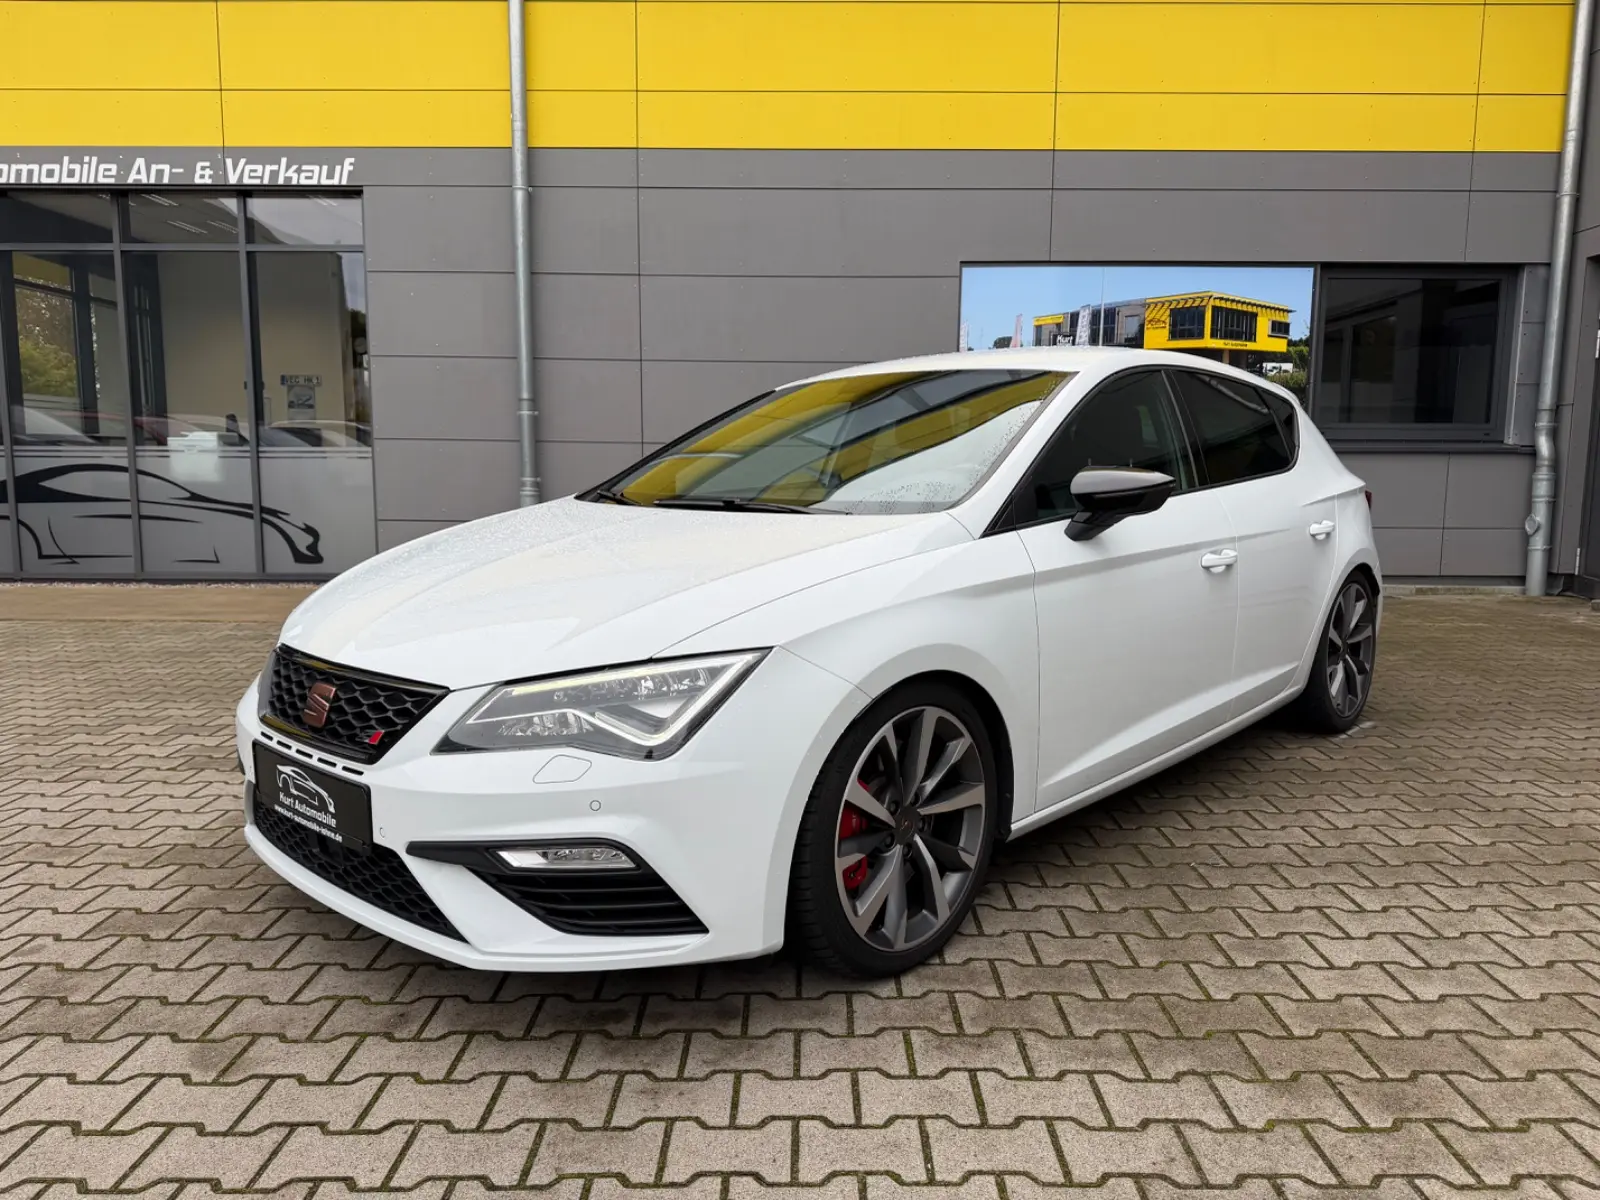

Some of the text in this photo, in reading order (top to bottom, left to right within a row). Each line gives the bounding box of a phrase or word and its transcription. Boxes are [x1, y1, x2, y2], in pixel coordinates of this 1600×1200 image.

[127, 157, 185, 184] An-
[194, 160, 214, 184] &
[225, 157, 356, 185] Verkauf
[279, 791, 337, 828] Kurt Automobile
